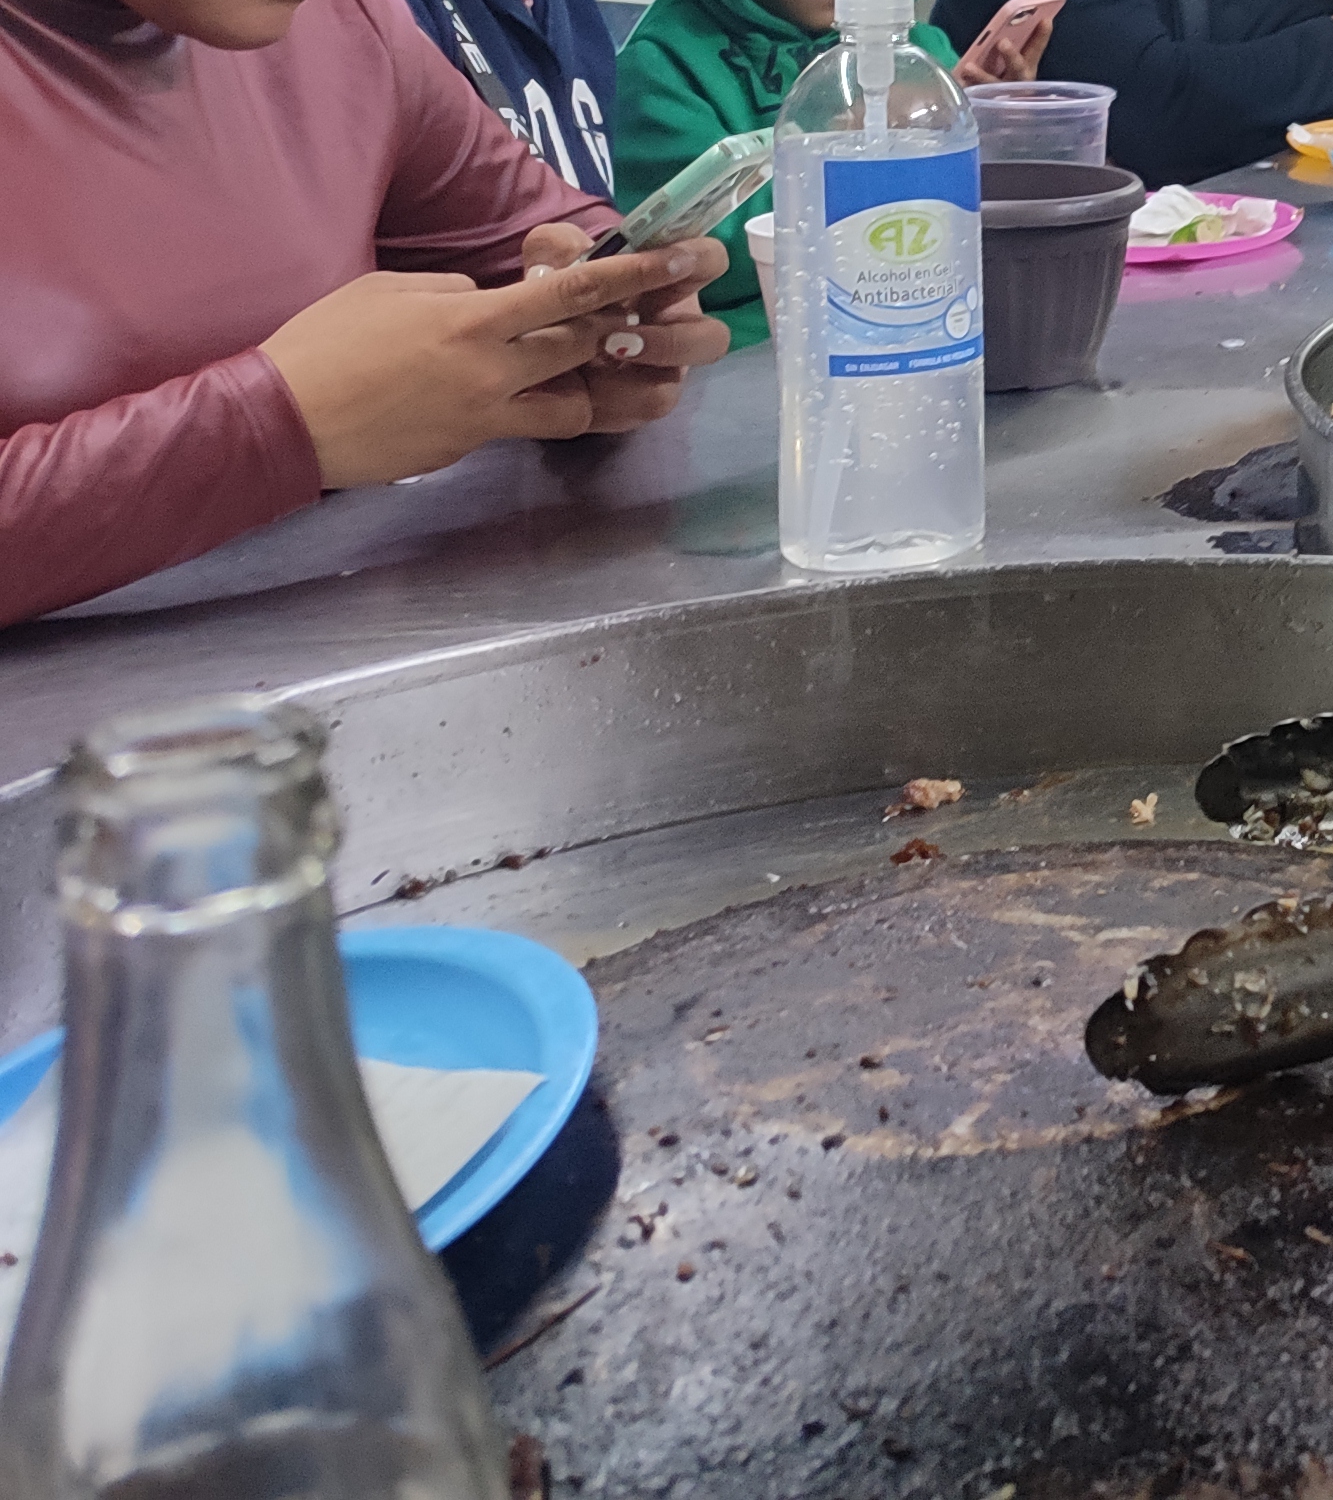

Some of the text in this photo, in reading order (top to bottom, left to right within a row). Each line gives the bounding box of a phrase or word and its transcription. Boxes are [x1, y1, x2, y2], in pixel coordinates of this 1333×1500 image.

[868, 217, 938, 256] AZ
[856, 263, 953, 284] Alcohol en Gel
[850, 278, 958, 306] Antibacterial
